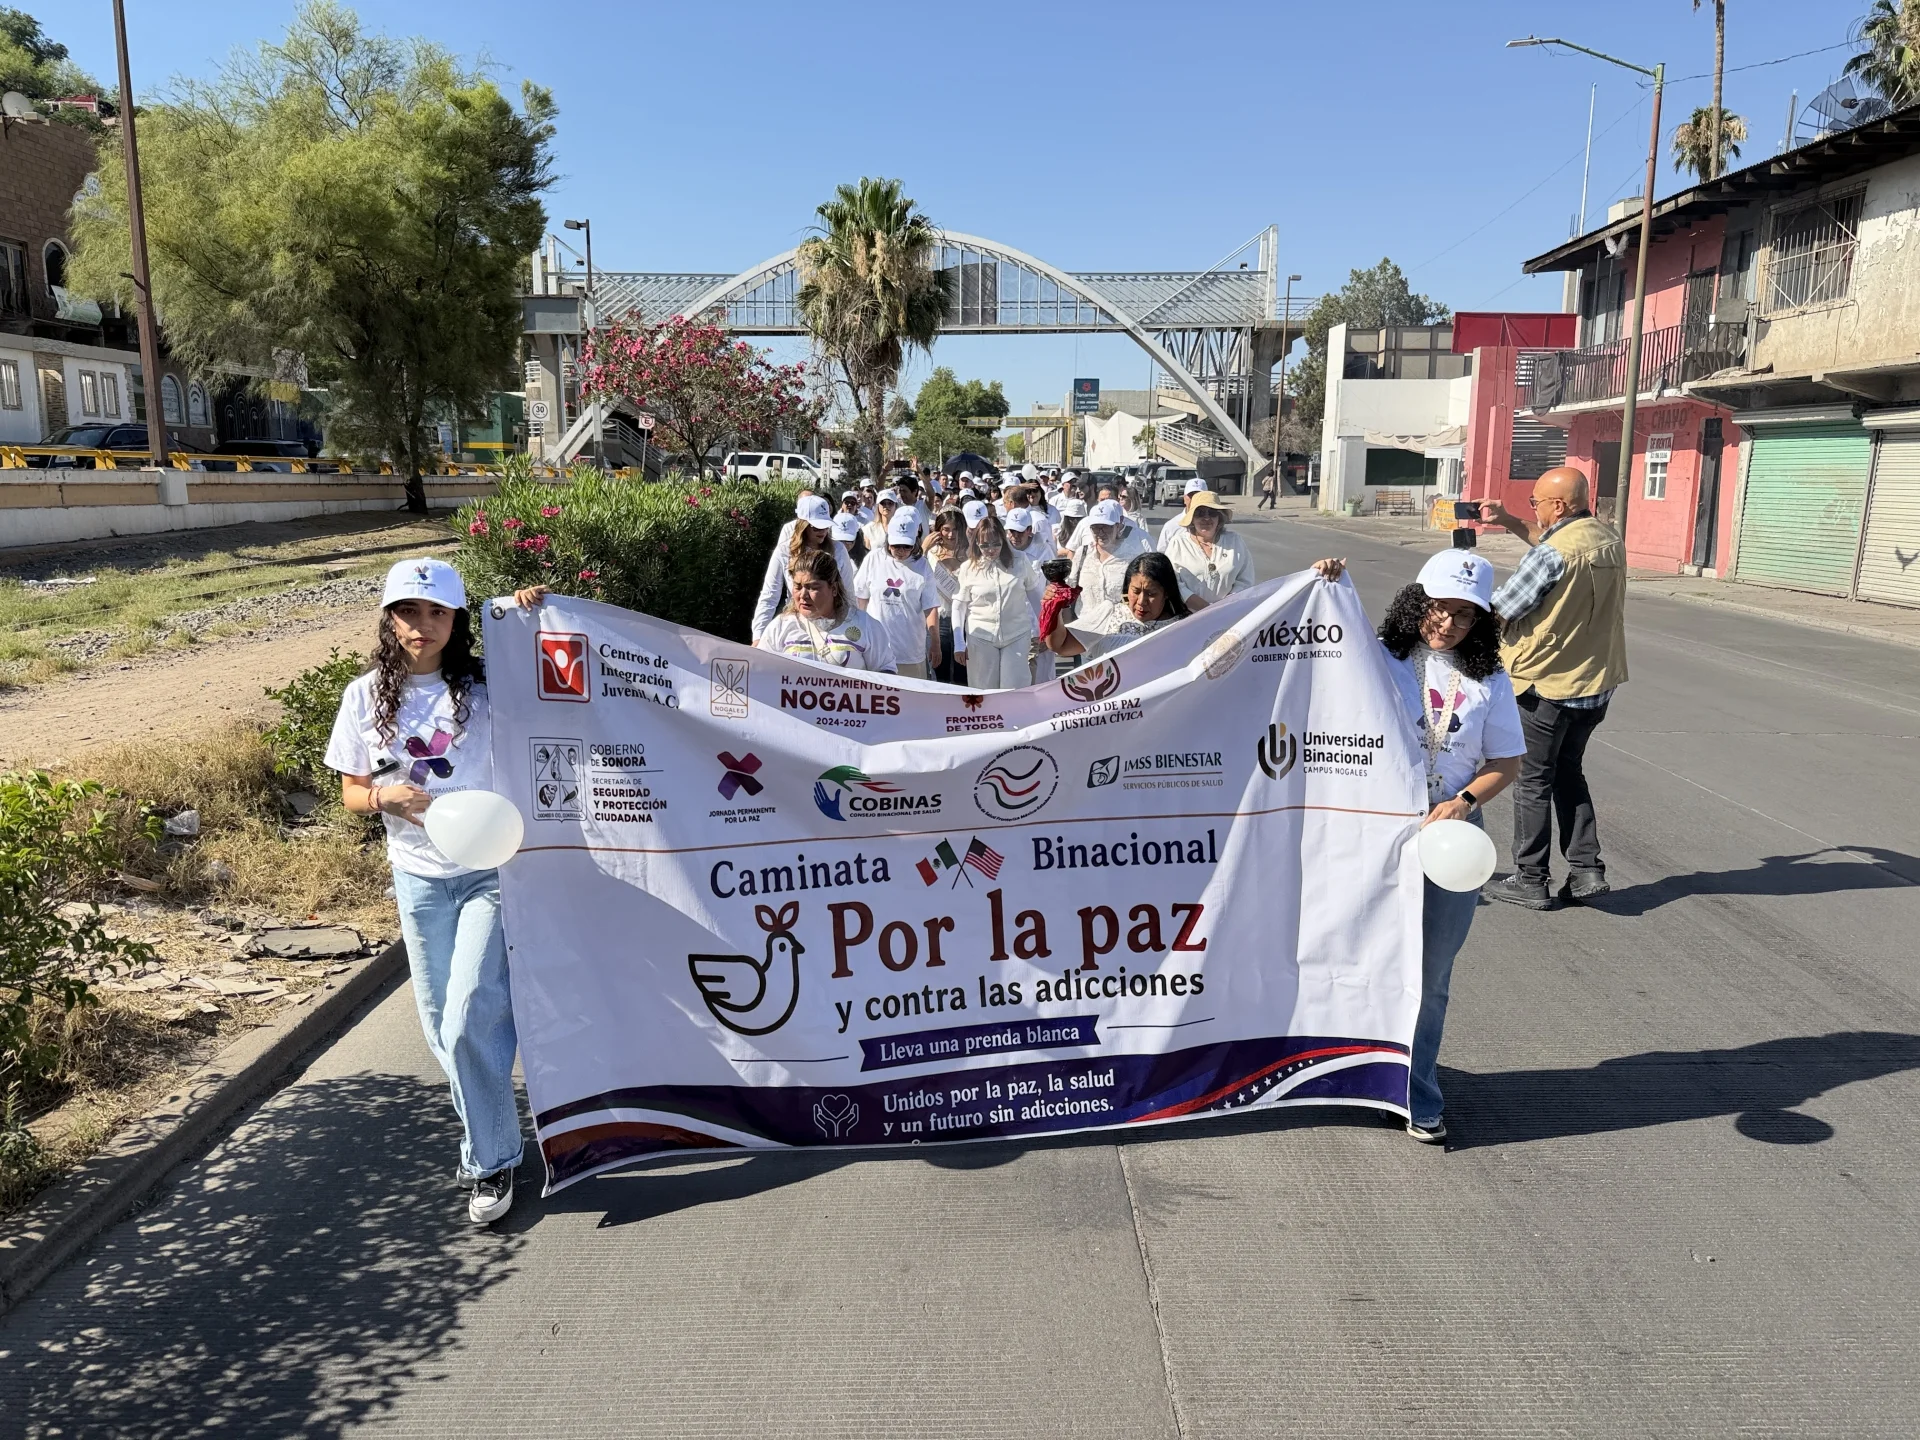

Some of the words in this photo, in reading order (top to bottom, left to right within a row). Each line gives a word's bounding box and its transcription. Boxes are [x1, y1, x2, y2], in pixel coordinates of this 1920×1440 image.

[536, 405, 545, 413] 30
[1656, 436, 1672, 449] RENTA
[1252, 618, 1343, 649] México
[599, 643, 651, 666] Centros
[653, 655, 669, 669] de
[1252, 652, 1295, 663] GOBIERNO
[1297, 651, 1309, 660] DE
[1309, 648, 1343, 659] MÉXICO
[600, 662, 673, 689] Integración
[781, 675, 793, 685] H.
[796, 676, 883, 690] AYUNTAMIENTO
[601, 682, 651, 703] Juvenil,
[653, 692, 680, 709] A.C.
[780, 689, 901, 716] NOGALES
[714, 705, 745, 714] NOGALES
[1052, 704, 1101, 719] CONSEJO
[1103, 701, 1119, 711] DE
[1120, 697, 1142, 710] PAZ
[816, 717, 867, 728] 2024-2027
[945, 714, 1004, 724] FRONTERA
[1050, 721, 1058, 731] Y
[1060, 714, 1108, 732] JUSTICIA
[1109, 710, 1144, 724] CÍVICA
[946, 724, 963, 733] DE
[964, 722, 1005, 731] TODOS
[1303, 731, 1384, 749] Universidad
[590, 743, 645, 755] GOBIERNO
[1013, 744, 1031, 752] Border
[1031, 745, 1046, 755] Health
[1440, 746, 1452, 754] PAZ
[591, 759, 600, 767] DE
[601, 756, 647, 768] SONORA
[1124, 755, 1152, 772] IMSS
[1155, 752, 1222, 769] BIENESTAR
[1303, 748, 1373, 766] Binacional
[1303, 766, 1333, 774] CAMPUS
[1335, 768, 1368, 777] NOGALES
[592, 777, 631, 785] SECRETARÍA
[1123, 781, 1156, 790] SERVICIOS
[1157, 779, 1190, 789] PÚBLICOS
[1191, 780, 1200, 788] DE
[1201, 779, 1223, 787] SALUD
[428, 785, 468, 795] PERMANENTE
[592, 787, 651, 798] SEGURIDAD
[594, 800, 601, 809] Y
[602, 798, 668, 811] PROTECCIÓN
[849, 793, 942, 812] COBINAS
[594, 812, 654, 823] CIUDADANA
[709, 809, 737, 818] JORNADA
[737, 806, 776, 816] PERMANENTE
[748, 814, 760, 823] PAZ
[710, 852, 891, 899] Caminata
[1031, 828, 1218, 871] Binacional
[827, 901, 955, 979] Por
[986, 888, 1052, 962] la
[1077, 903, 1208, 971] paz
[835, 1000, 853, 1034] y
[865, 984, 967, 1021] contra
[978, 975, 1023, 1008] las
[1035, 966, 1205, 1003] adicciones
[880, 1042, 924, 1062] Lleva
[929, 1038, 959, 1055] una
[965, 1028, 1022, 1054] prenda
[1026, 1025, 1080, 1044] blanca
[883, 1089, 944, 1114] Unidos
[950, 1085, 980, 1107] por
[986, 1080, 1001, 1099] la
[1007, 1077, 1042, 1101] paz,
[1048, 1074, 1064, 1092] la
[1069, 1069, 1115, 1091] salud
[883, 1121, 894, 1136] y
[901, 1119, 923, 1133] un
[929, 1110, 983, 1132] futuro
[989, 1104, 1015, 1124] sin
[1021, 1097, 1114, 1121] adicciones.
